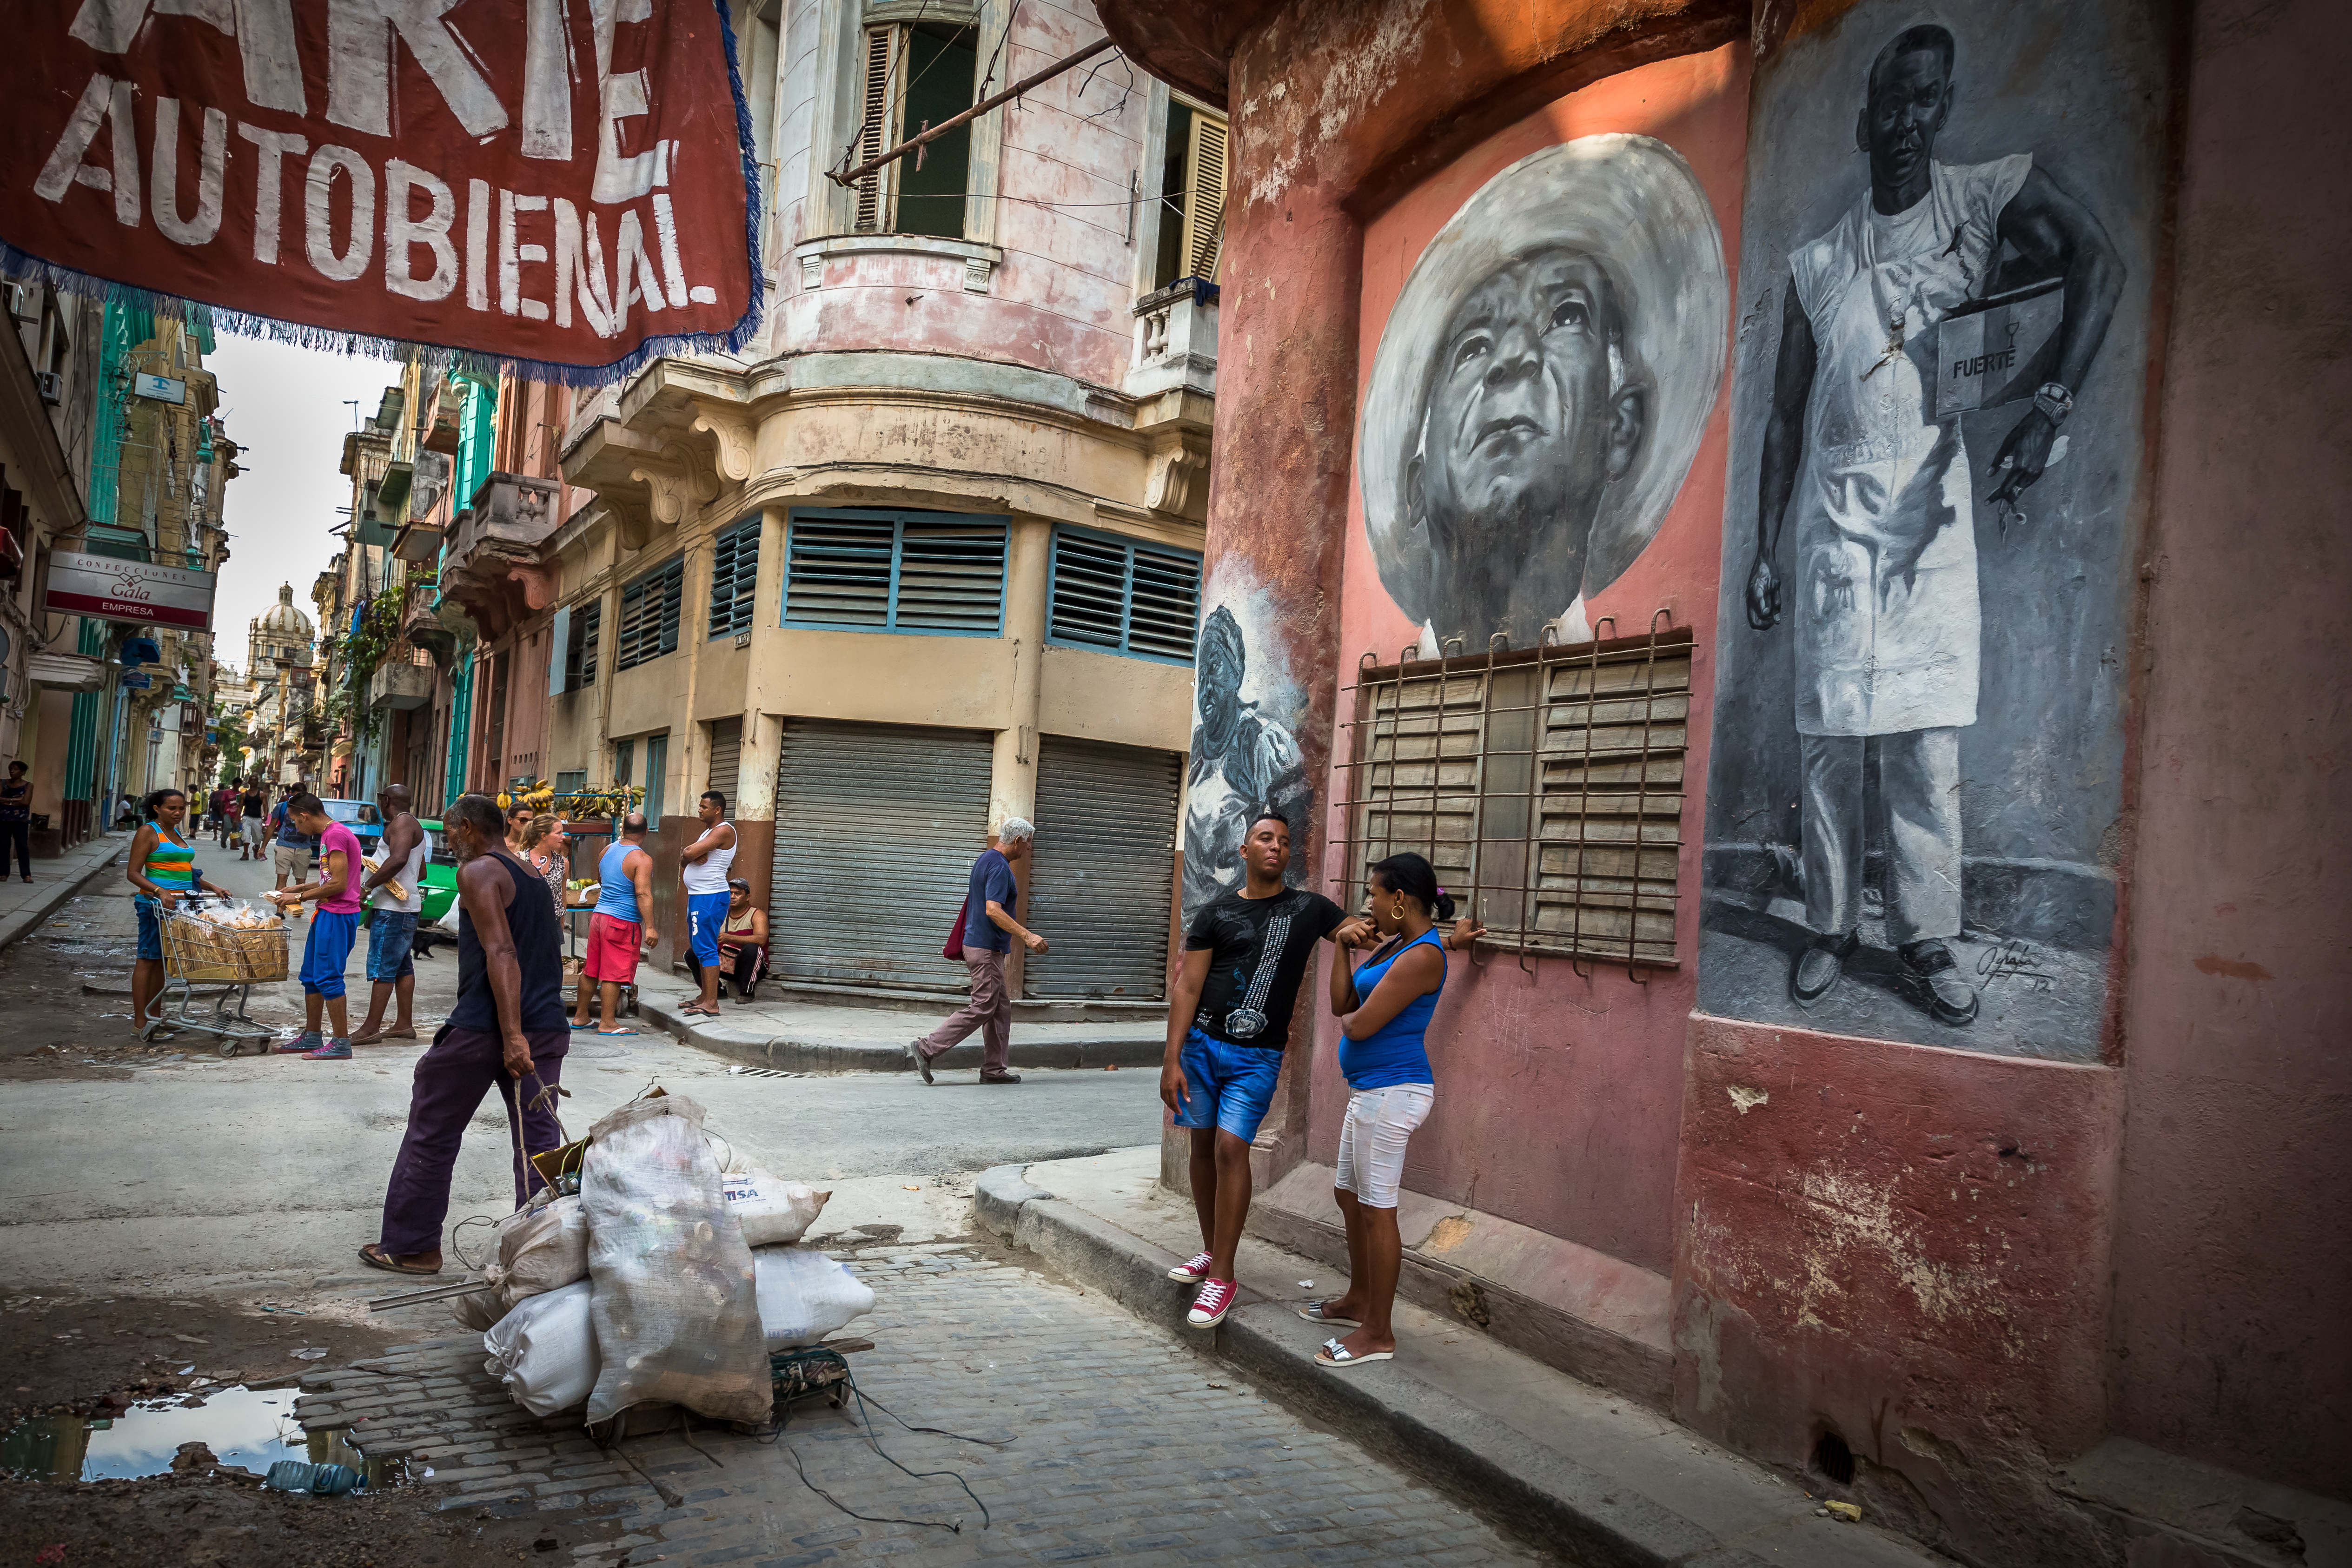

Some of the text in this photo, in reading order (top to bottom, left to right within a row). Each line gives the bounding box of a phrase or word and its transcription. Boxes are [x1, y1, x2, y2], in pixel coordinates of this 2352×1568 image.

[1953, 348, 2016, 379] FUERTE
[111, 583, 151, 601] Gala
[102, 602, 154, 616] EMPRESA
